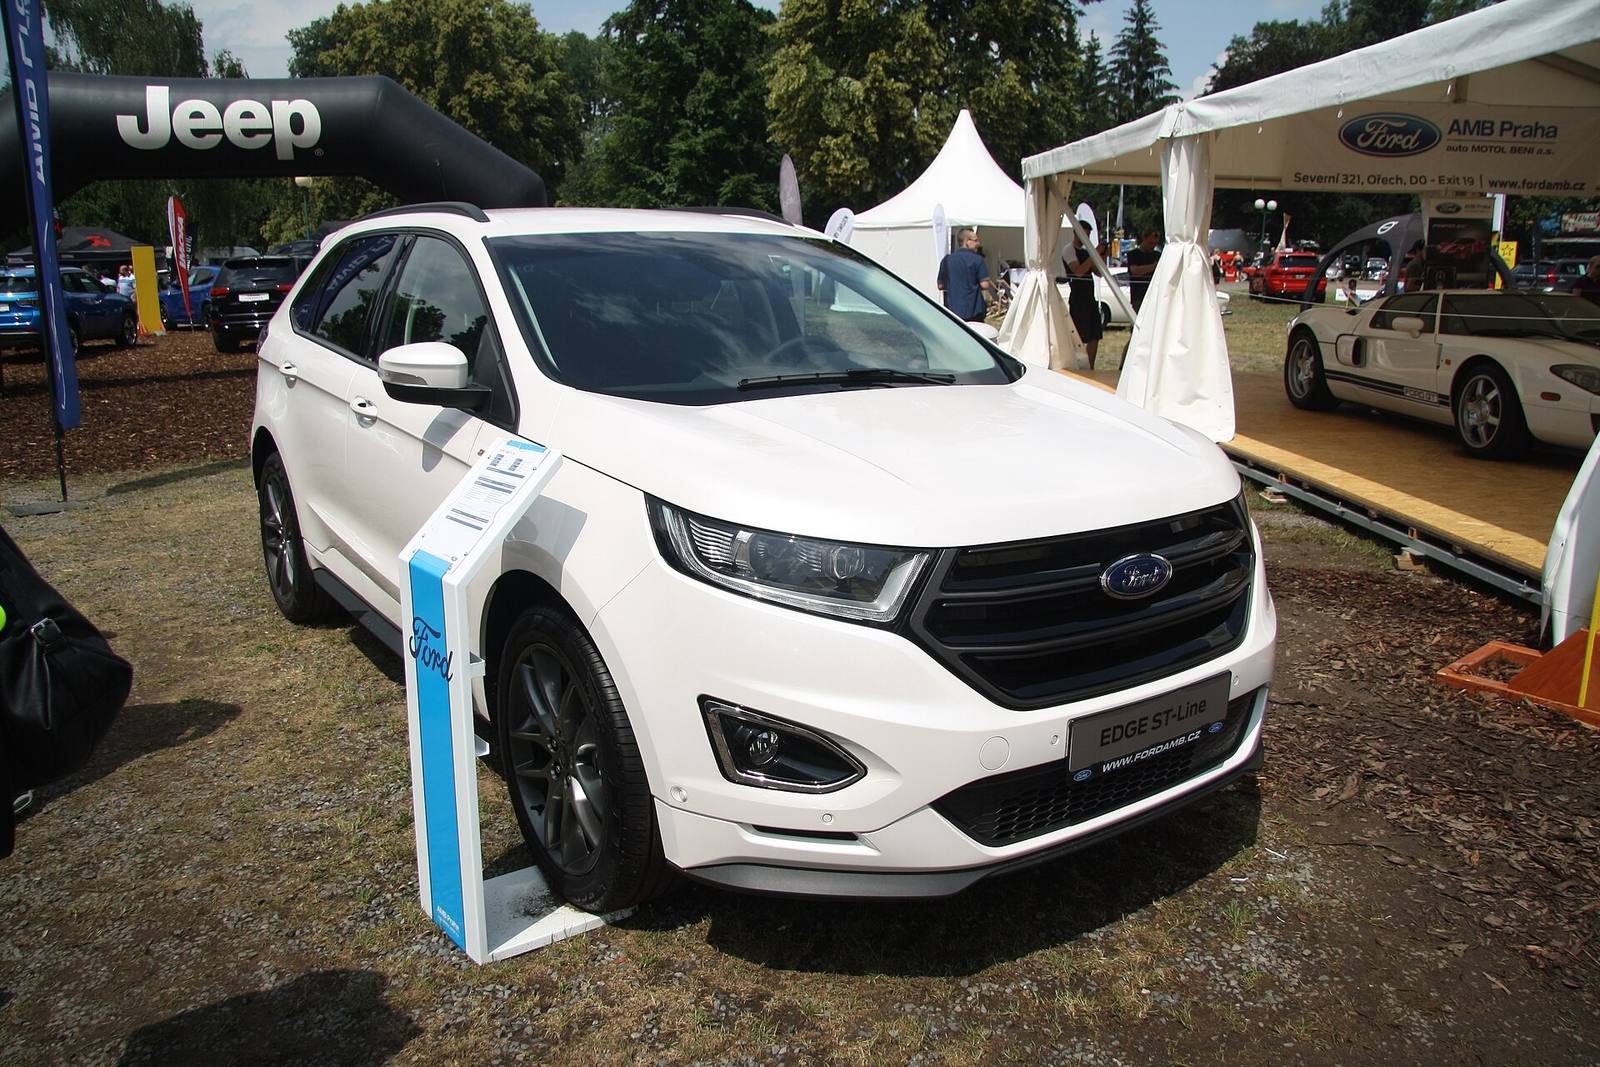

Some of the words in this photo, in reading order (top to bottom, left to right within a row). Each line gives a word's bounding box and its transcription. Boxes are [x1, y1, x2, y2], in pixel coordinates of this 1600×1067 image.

[116, 85, 322, 160] Jeep
[1357, 118, 1423, 150] Ford
[1447, 118, 1495, 137] AMB
[1499, 121, 1558, 139] Praha
[1446, 145, 1469, 153] auto
[1471, 145, 1507, 154] MOTOL
[1293, 172, 1340, 185] Severní
[1341, 173, 1364, 186] 321,
[1438, 175, 1460, 186] Exit
[1463, 176, 1475, 187] 19
[1488, 178, 1586, 191] www.fordamb.cz
[408, 616, 454, 682] Ford
[1101, 717, 1148, 746] EDGE
[1151, 699, 1207, 731] ST-Line
[1102, 729, 1203, 773] WWW.FORDAMB.CZ
